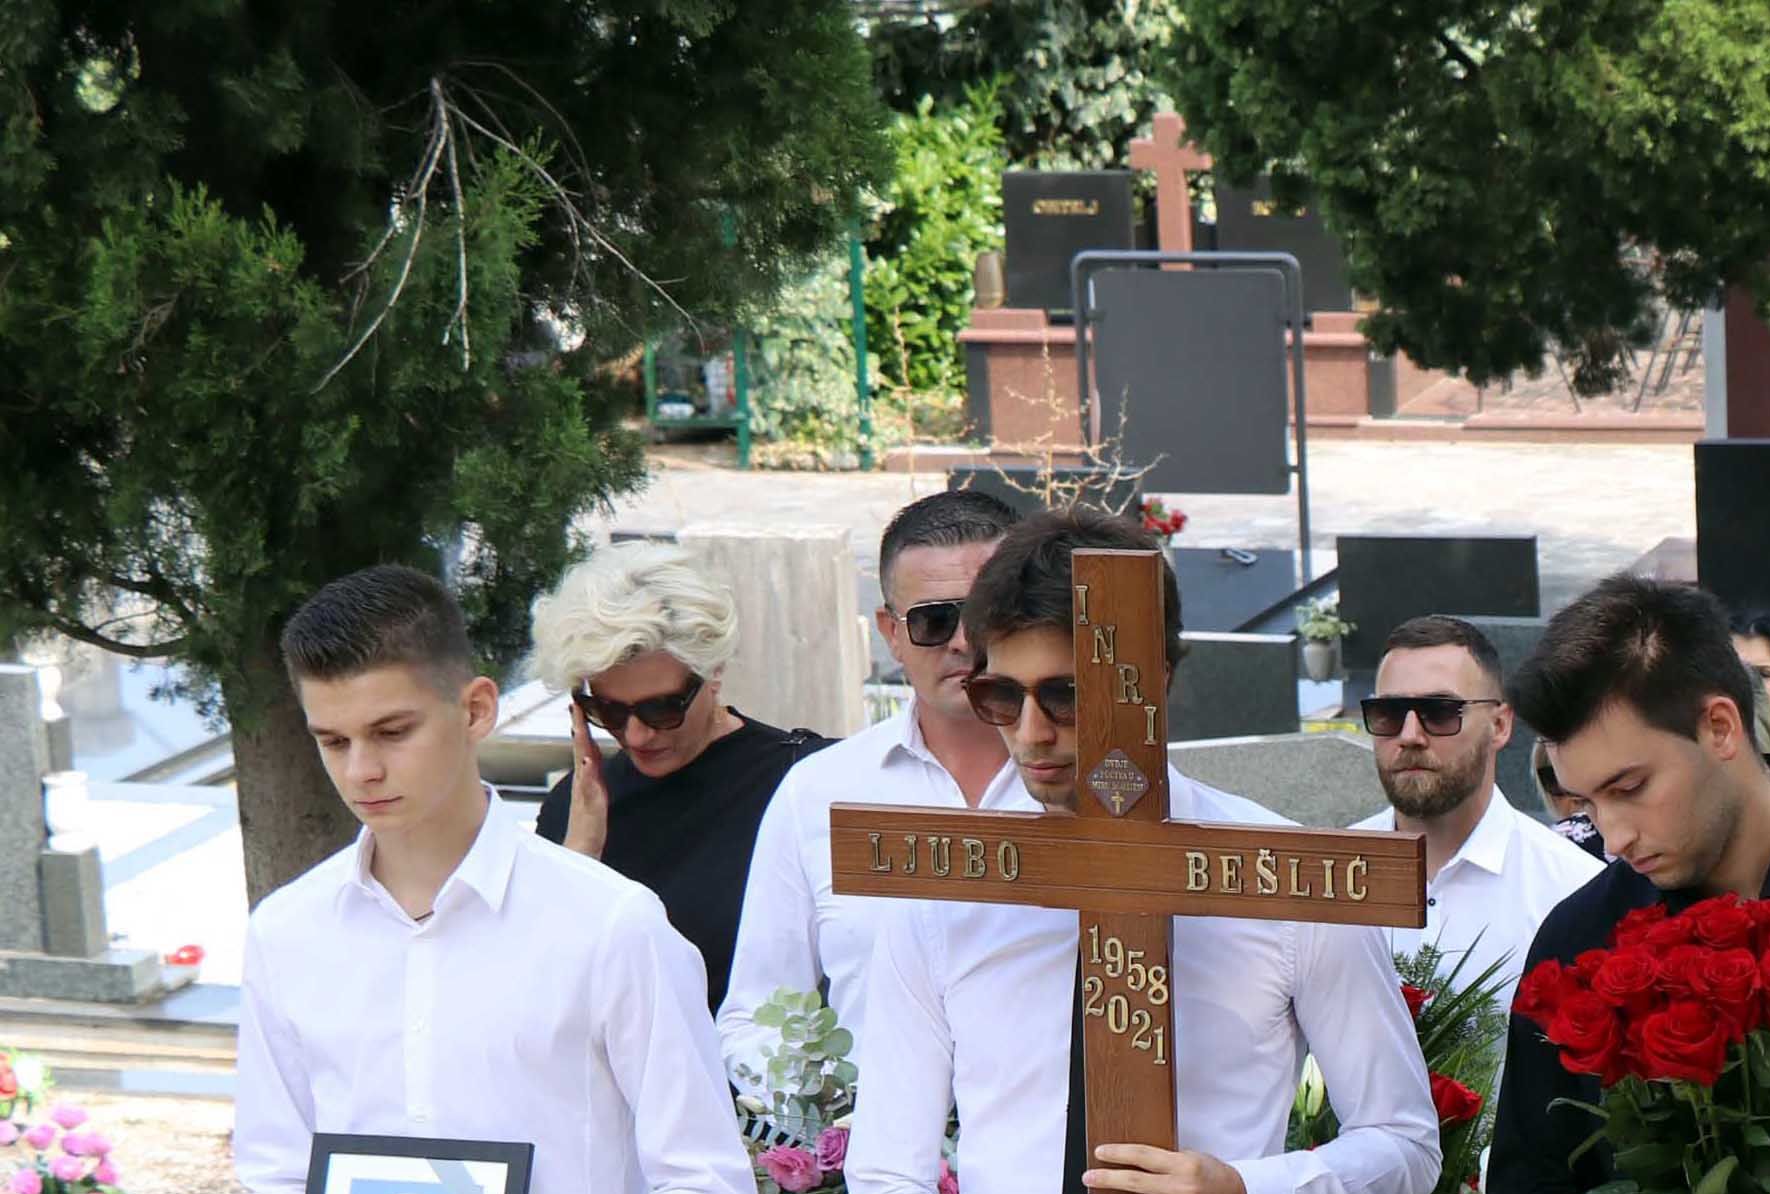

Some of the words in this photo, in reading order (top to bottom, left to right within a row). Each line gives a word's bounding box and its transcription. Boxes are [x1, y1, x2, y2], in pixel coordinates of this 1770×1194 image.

[1074, 585, 1157, 745] INRI
[868, 832, 1021, 882] LJUBO
[1185, 848, 1370, 901] BEŠLIĆ
[1087, 923, 1170, 1006] 1958
[1084, 976, 1167, 1065] 2021
